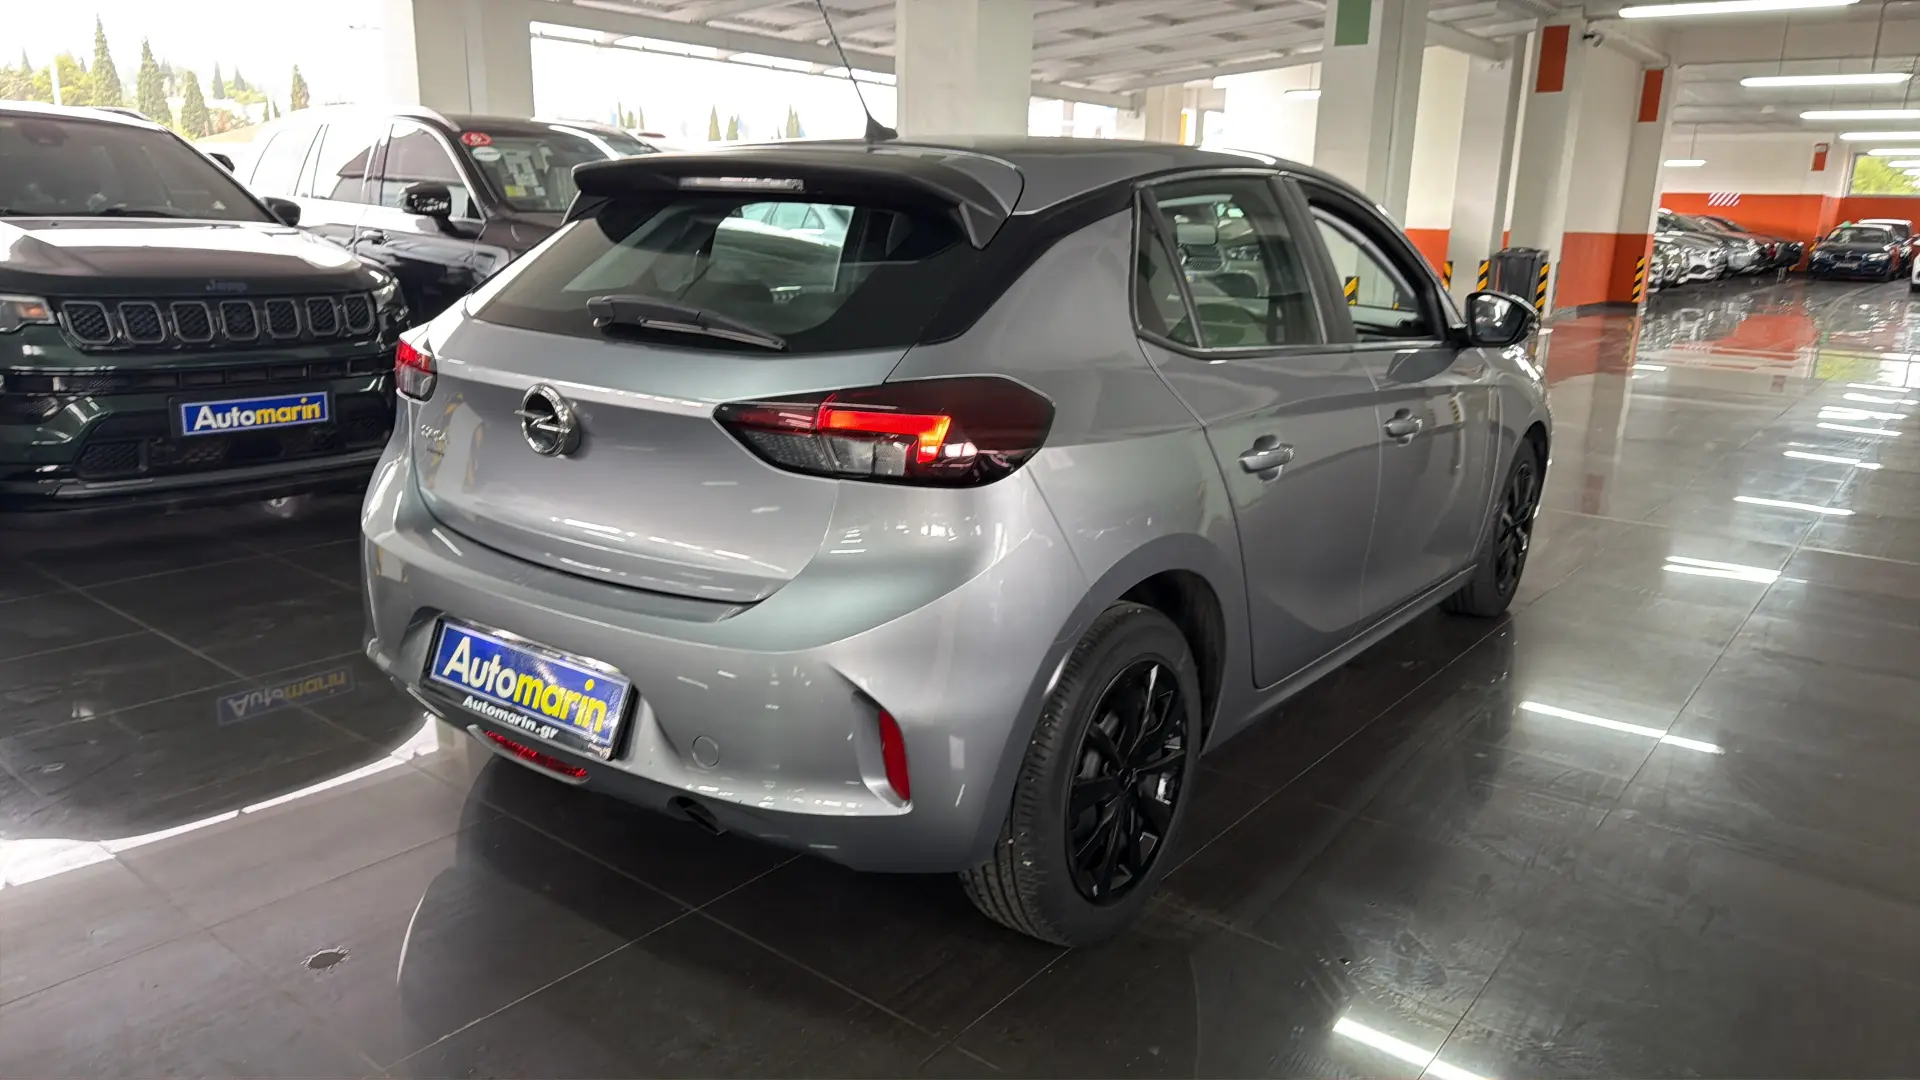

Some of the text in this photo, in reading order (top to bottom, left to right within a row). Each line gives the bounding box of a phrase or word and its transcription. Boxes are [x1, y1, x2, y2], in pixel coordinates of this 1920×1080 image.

[193, 397, 321, 431] Automarin
[442, 635, 608, 733] Automarin
[462, 695, 559, 739] Automarin.gr
